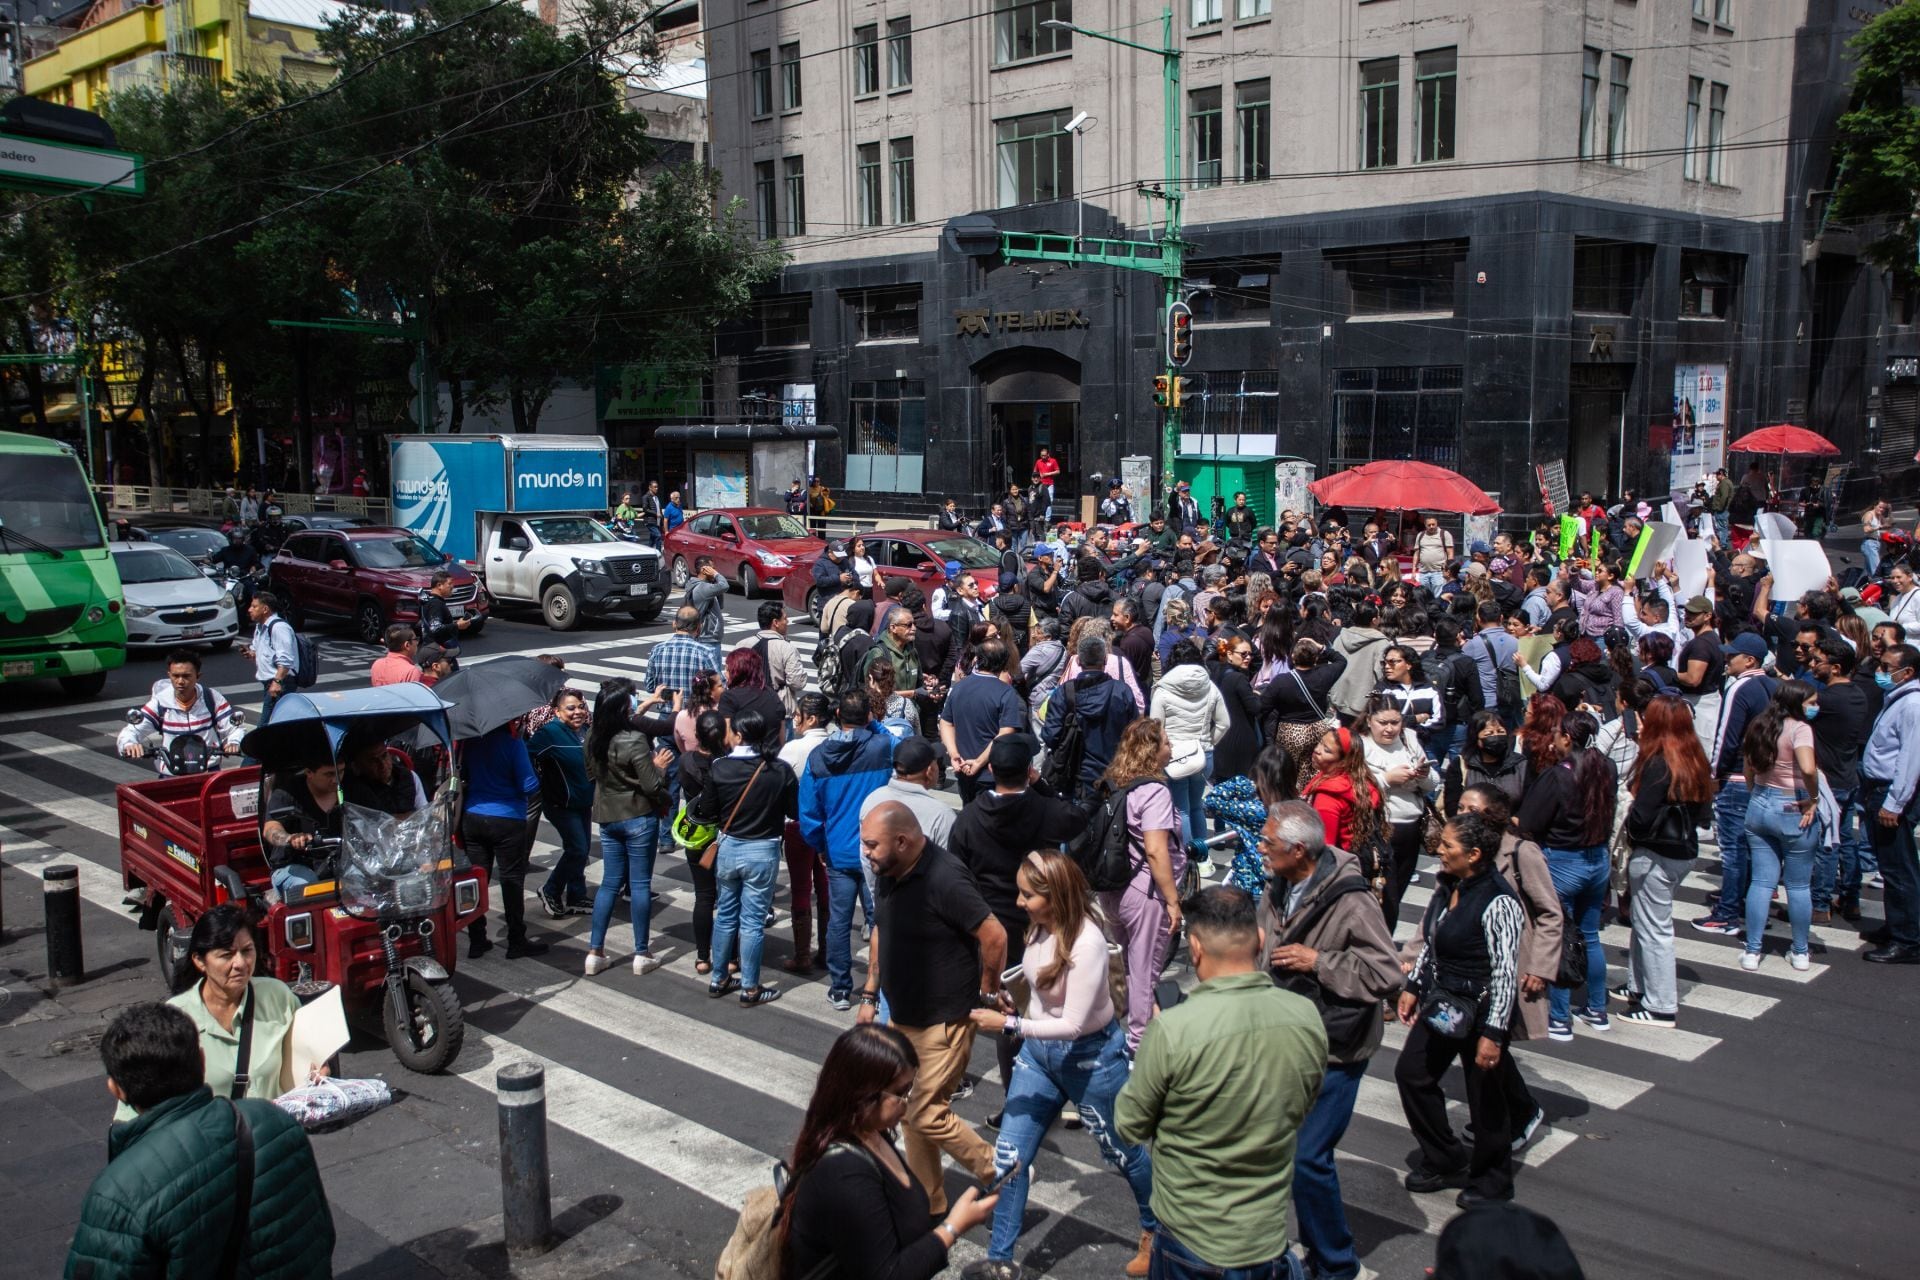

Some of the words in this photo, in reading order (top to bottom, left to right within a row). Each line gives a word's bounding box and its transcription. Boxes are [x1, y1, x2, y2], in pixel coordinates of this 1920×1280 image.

[0, 150, 36, 163] adero
[518, 468, 585, 489] mundo
[588, 472, 603, 487] in
